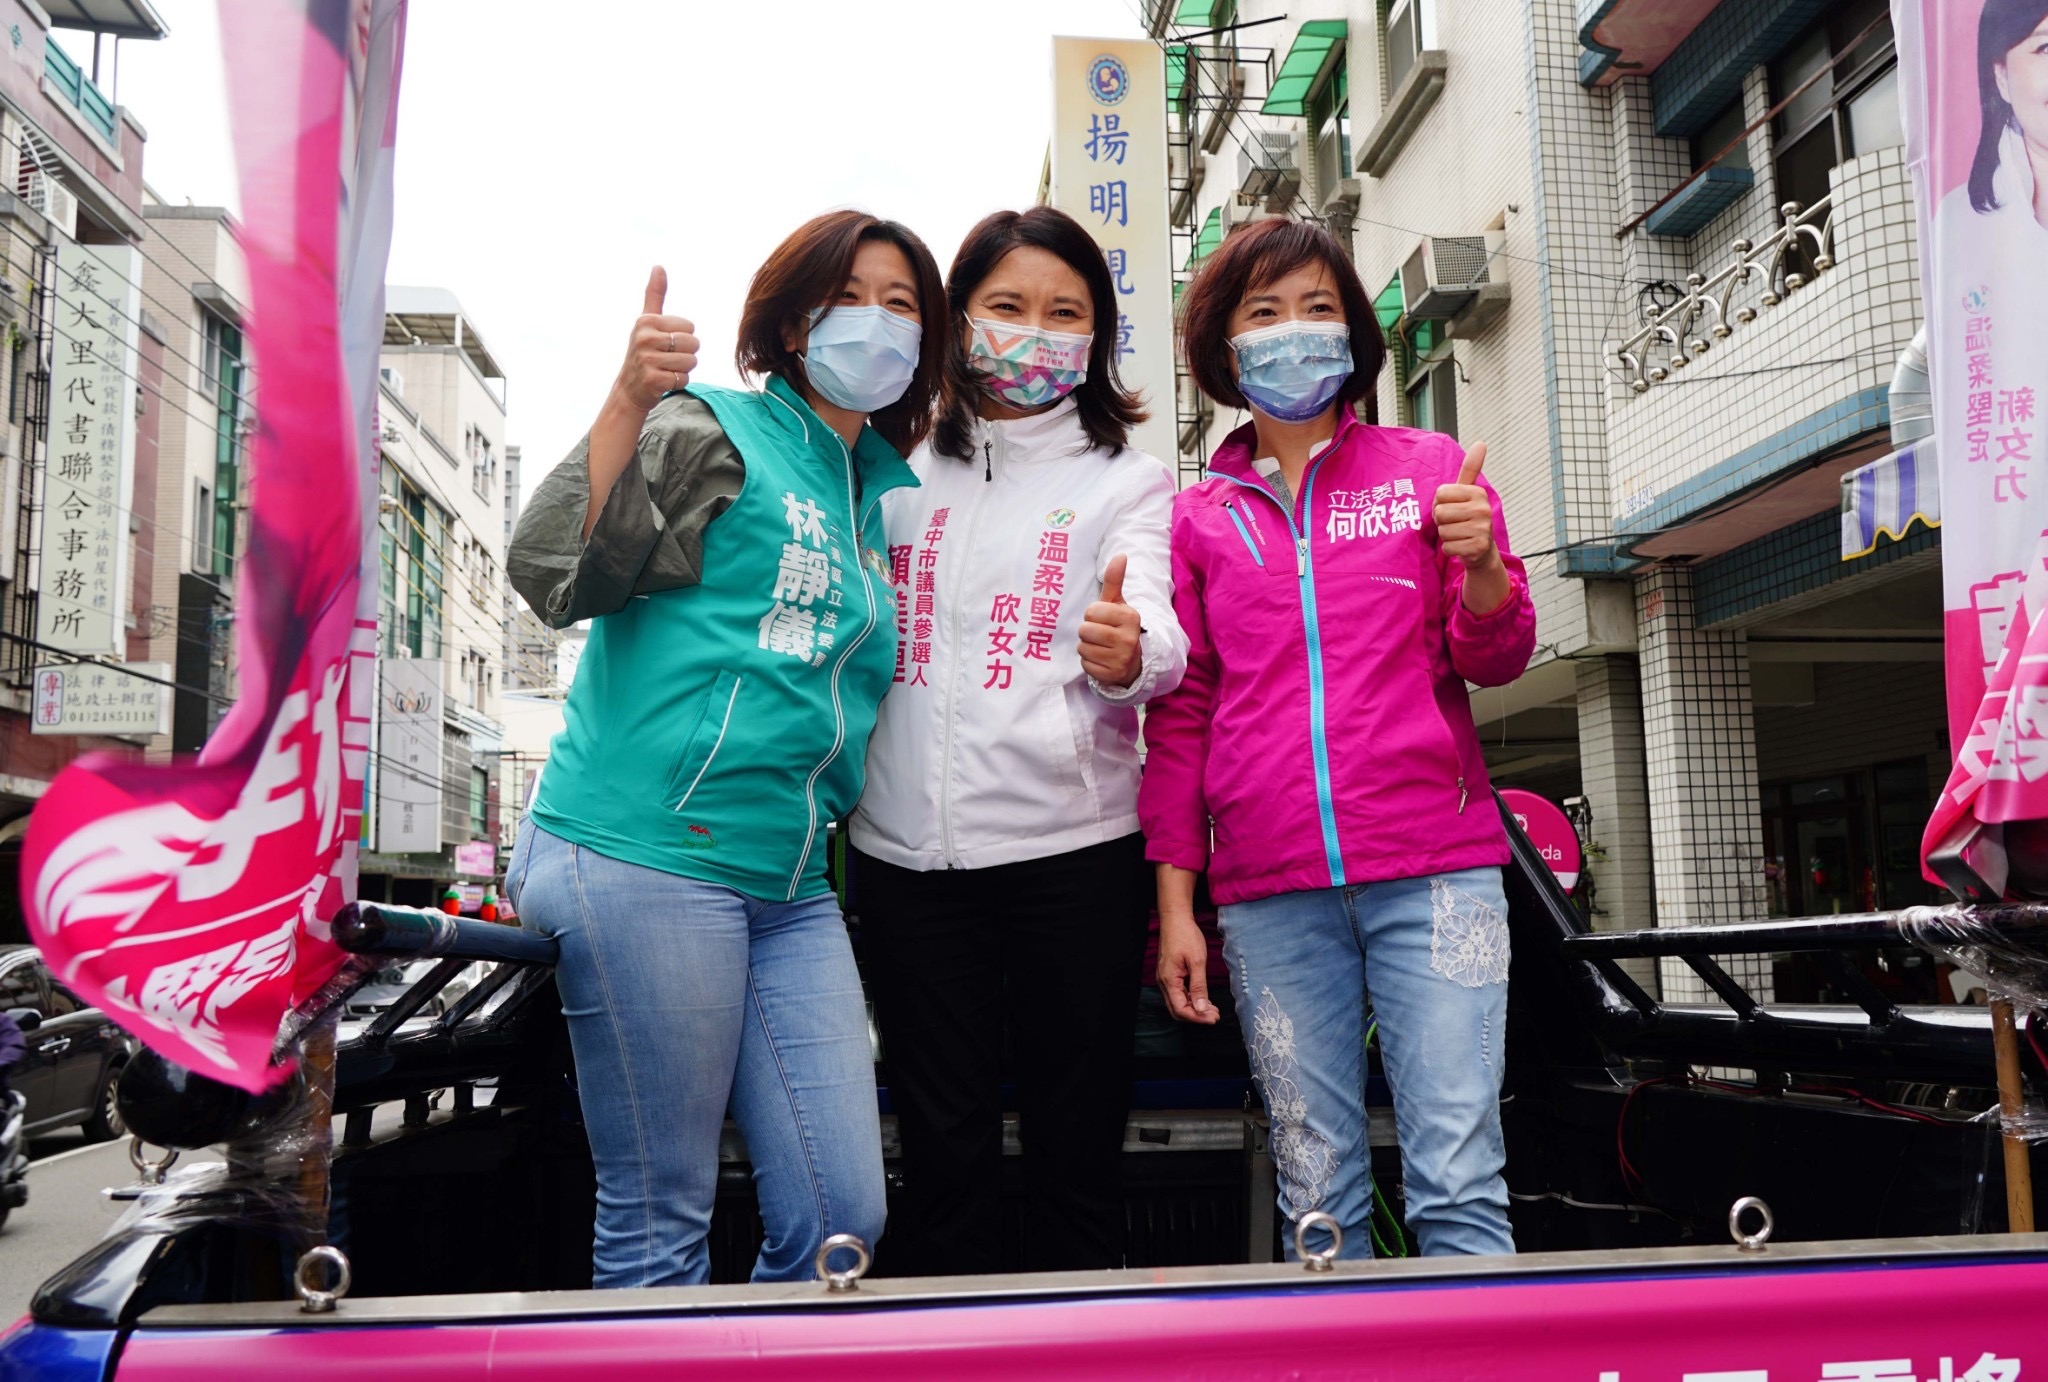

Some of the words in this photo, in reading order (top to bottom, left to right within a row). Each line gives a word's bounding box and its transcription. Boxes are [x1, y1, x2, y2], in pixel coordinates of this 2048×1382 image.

[51, 260, 102, 639] 鑫大里代書聯合事務所
[1326, 497, 1422, 544] 何欣純
[1327, 478, 1416, 510] 立法委員
[757, 490, 829, 664] 林靜儀
[910, 507, 951, 688] 臺中市議員參選人
[983, 592, 1022, 690] 欣女力
[40, 672, 61, 723] 專業
[65, 692, 156, 706] 地政士辦理
